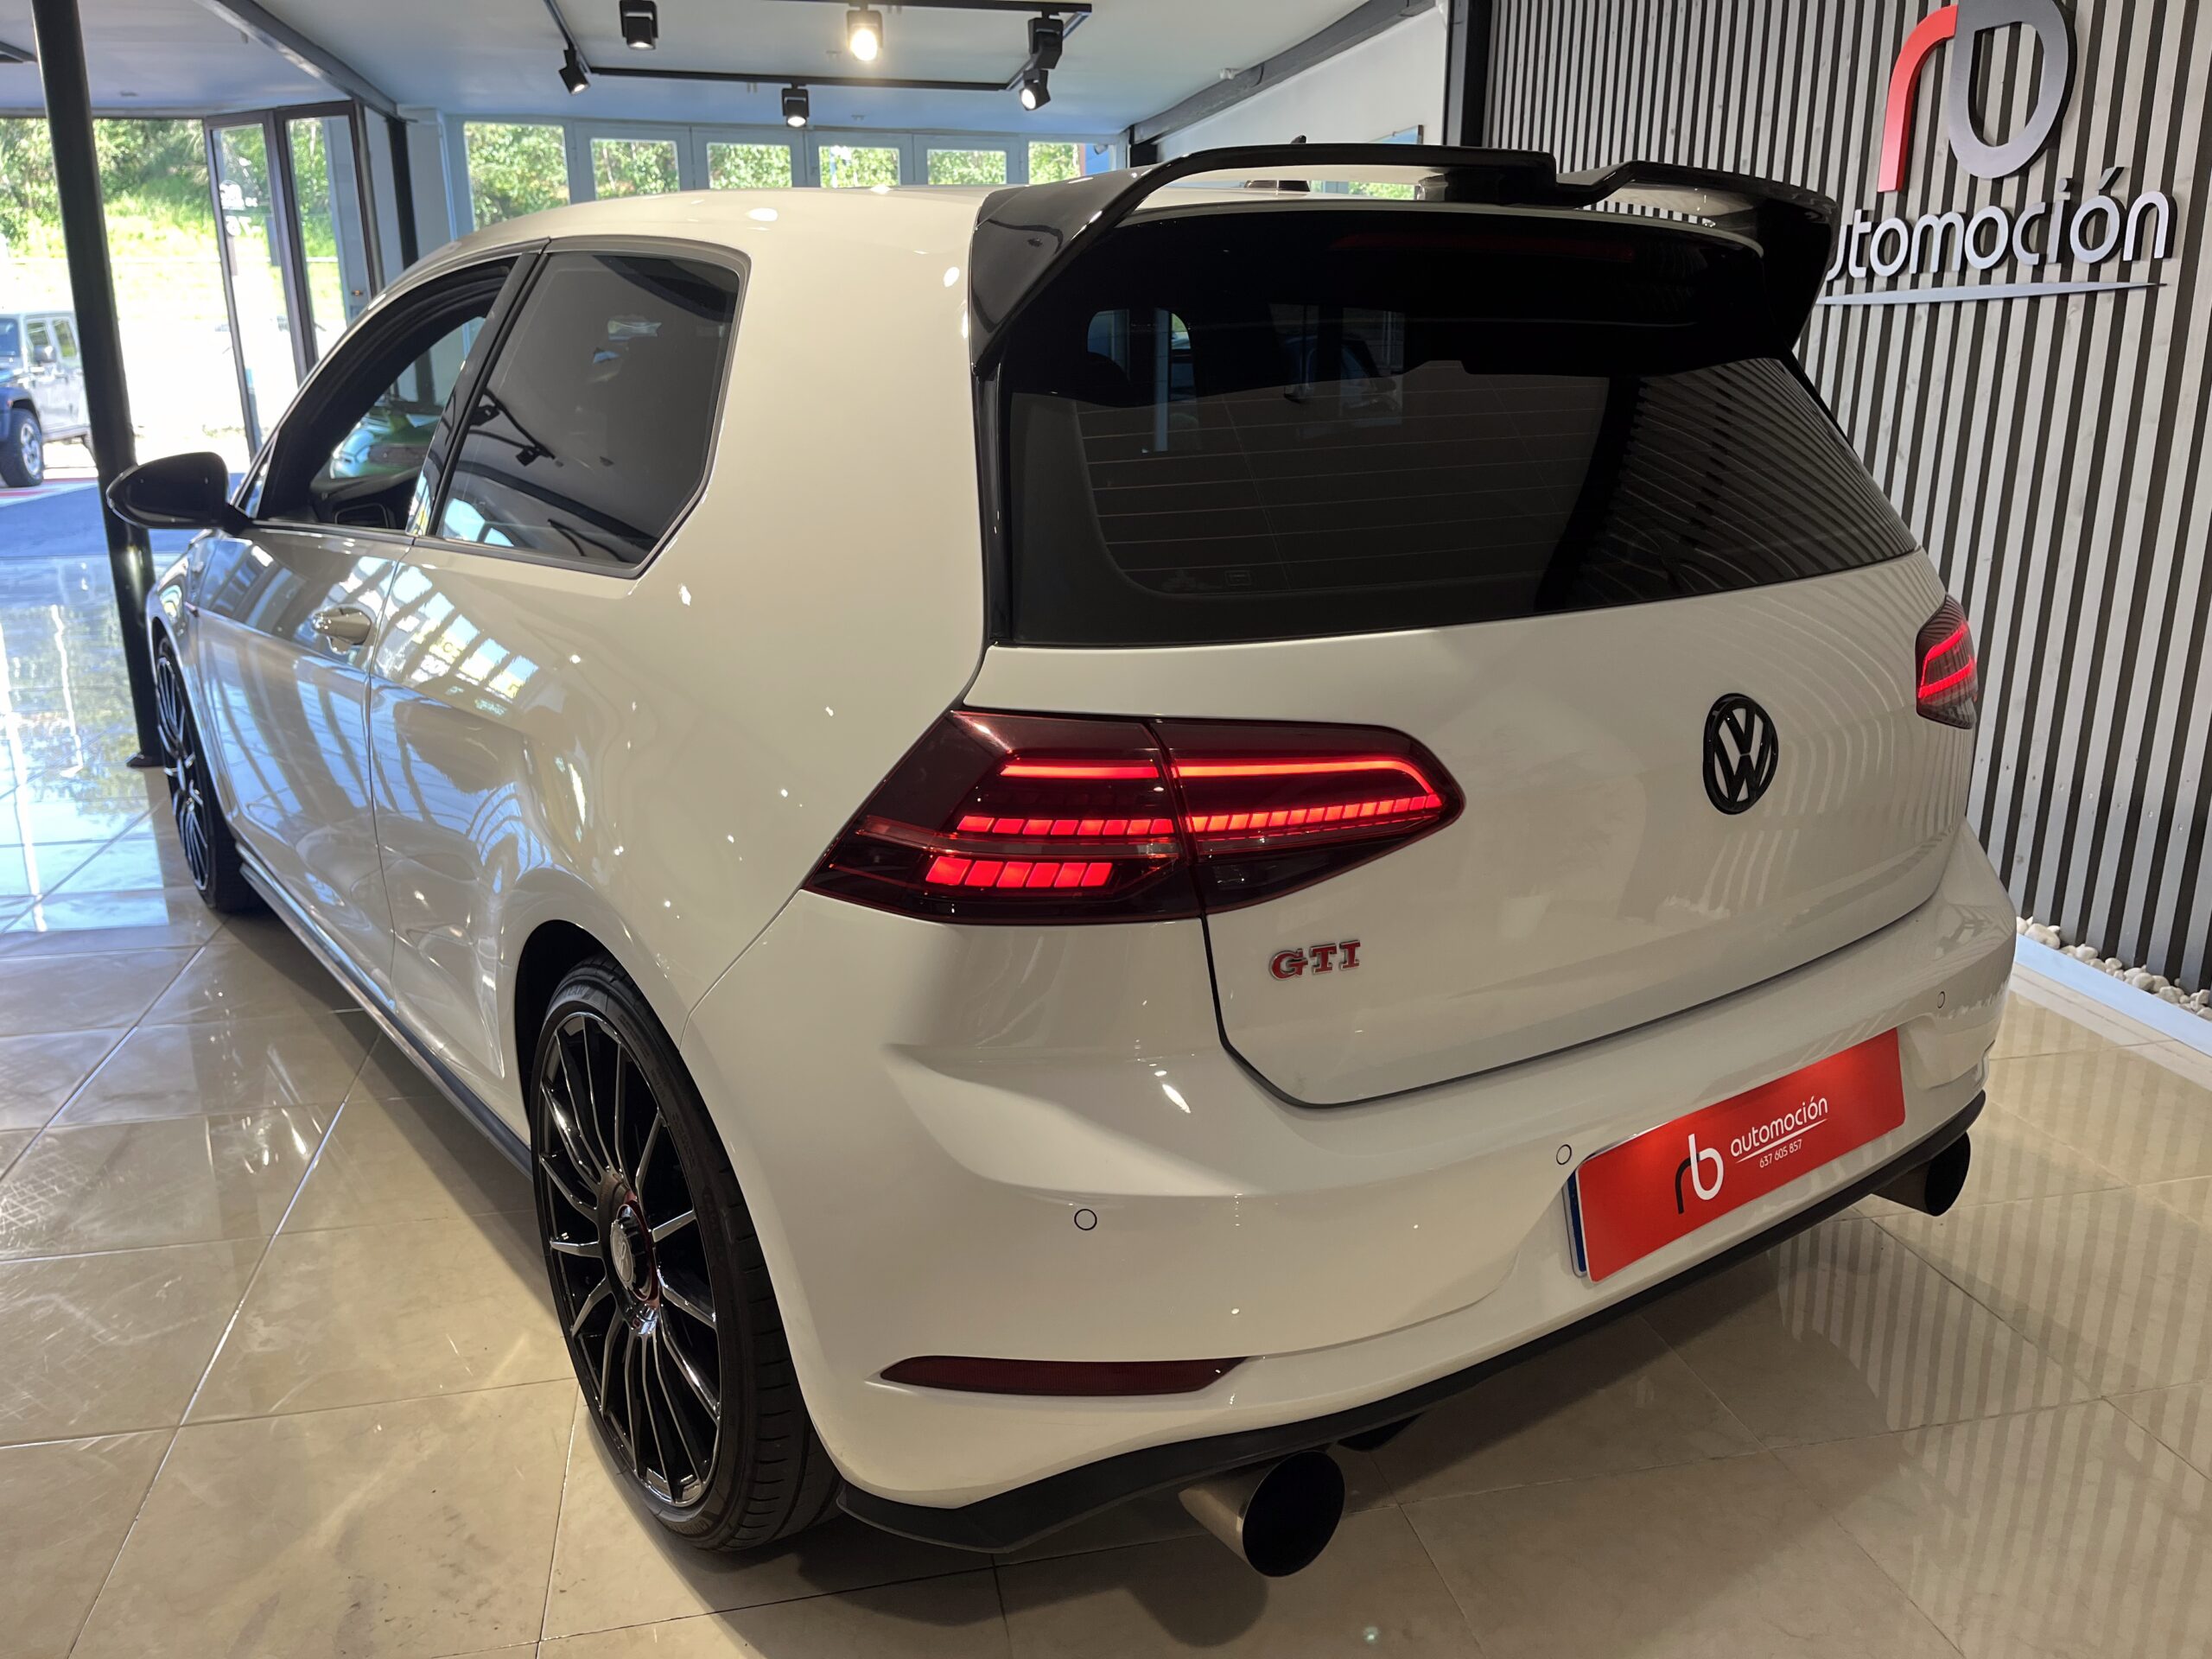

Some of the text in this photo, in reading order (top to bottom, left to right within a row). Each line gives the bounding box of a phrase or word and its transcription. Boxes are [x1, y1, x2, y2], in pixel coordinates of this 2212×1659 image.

[1826, 167, 2174, 281] utomoción
[1268, 939, 1361, 981] GTI
[1731, 1096, 1828, 1157] automoción
[1759, 1139, 1802, 1168] 637 605 857
[1675, 1133, 1724, 1215] rb
